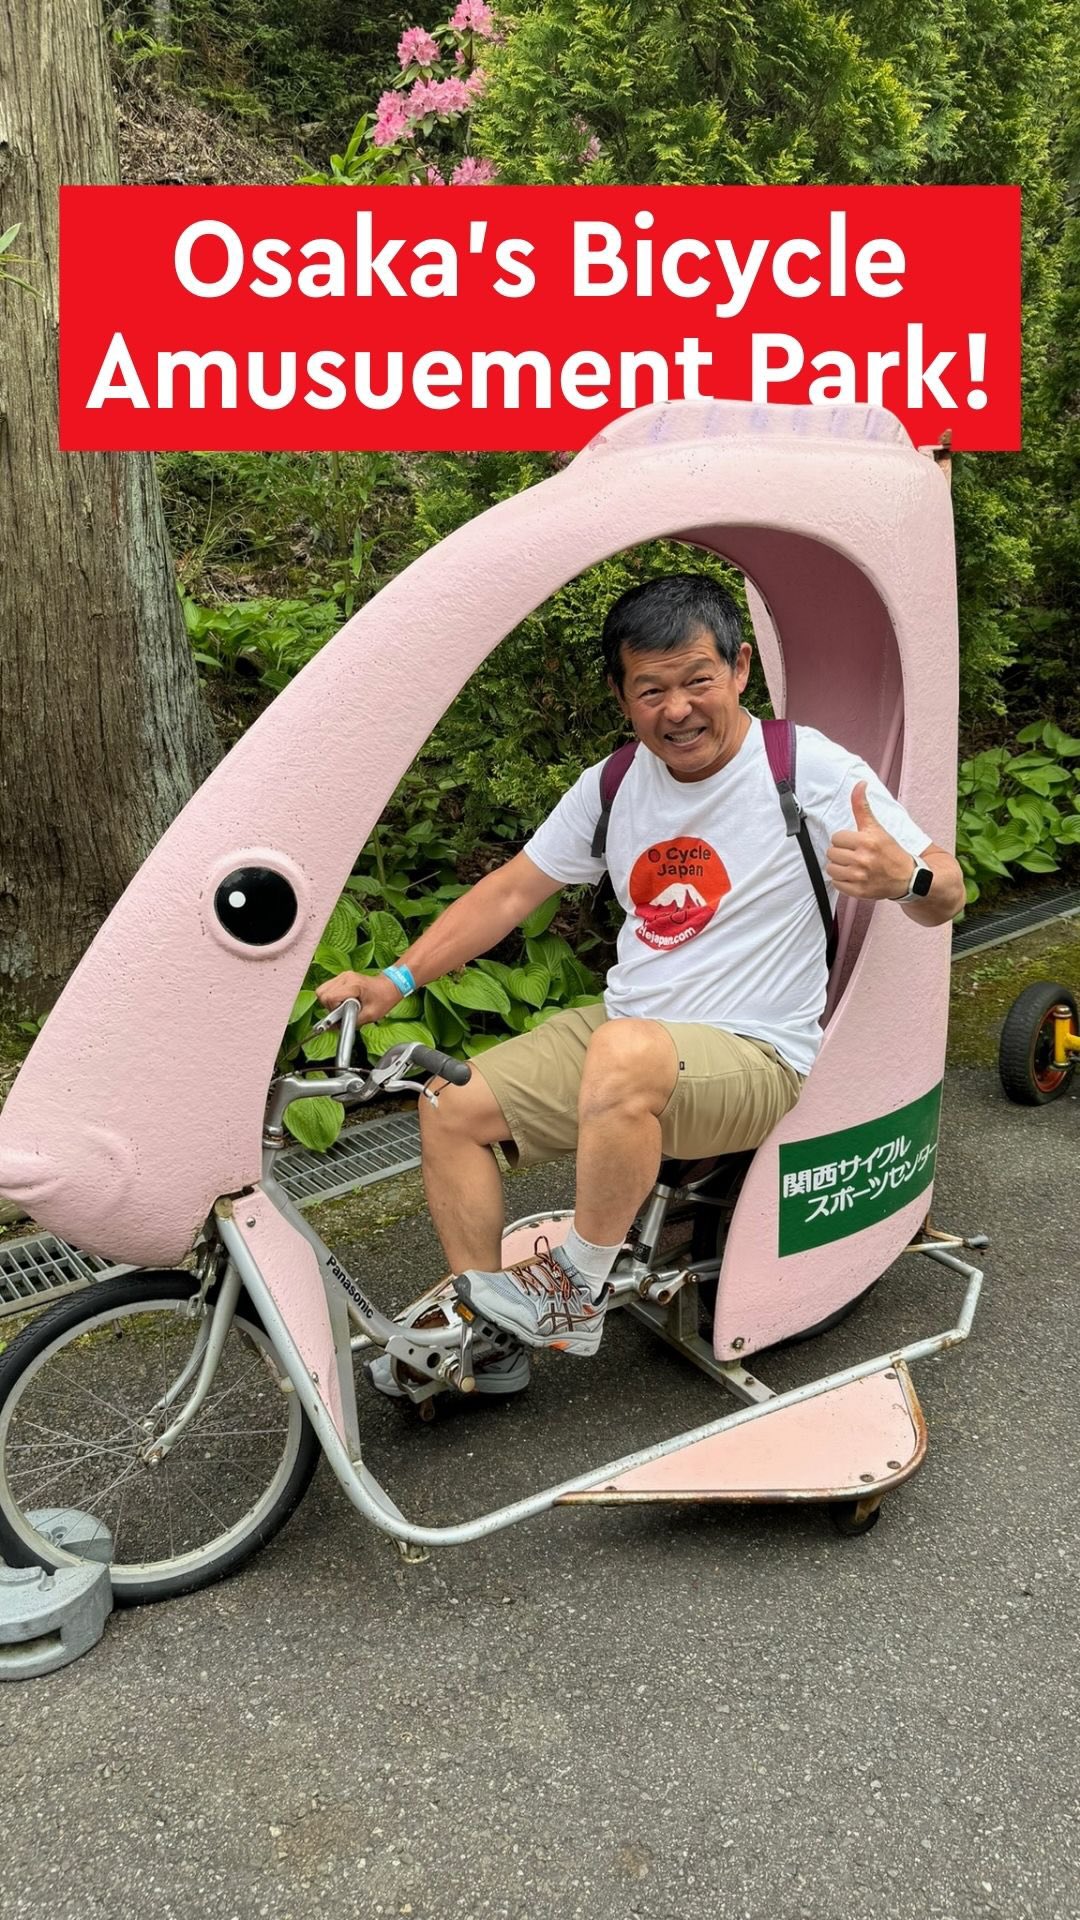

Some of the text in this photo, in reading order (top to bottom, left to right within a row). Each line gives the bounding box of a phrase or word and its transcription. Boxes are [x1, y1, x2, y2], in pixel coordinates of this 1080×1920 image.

[657, 864, 703, 878] Japan
[665, 845, 711, 863] Cycle
[783, 1135, 912, 1199] 関西サイクル
[804, 1143, 938, 1223] スポーツセンター
[326, 1255, 374, 1319] Panasonic
